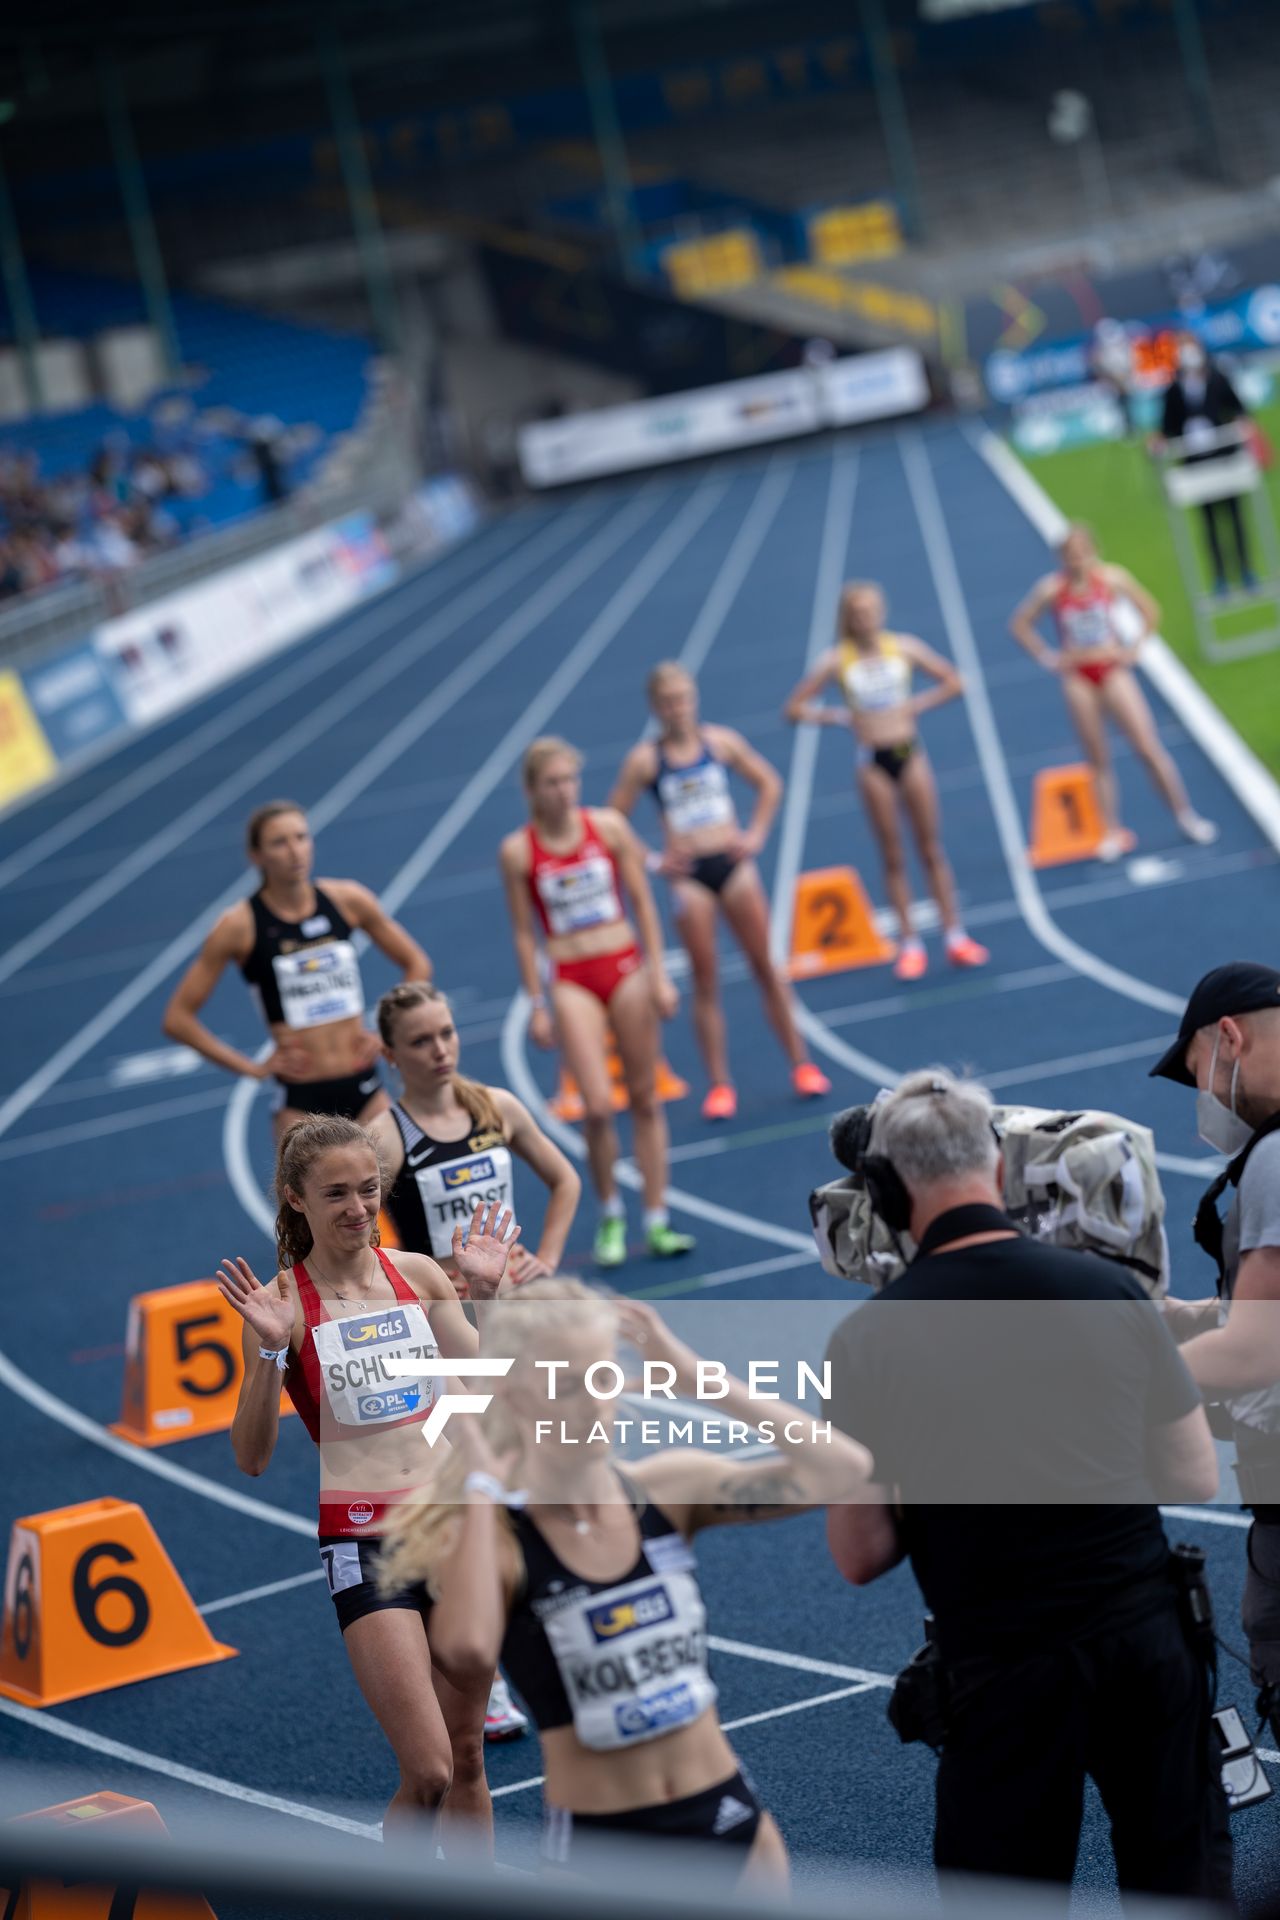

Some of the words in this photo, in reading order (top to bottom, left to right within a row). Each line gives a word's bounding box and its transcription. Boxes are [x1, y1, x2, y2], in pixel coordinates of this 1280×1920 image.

[1057, 785, 1083, 838] 1
[809, 888, 858, 947] 2
[433, 1183, 508, 1223] TROST
[175, 1313, 235, 1396] 5
[378, 1319, 403, 1337] GLS
[13, 1553, 34, 1660] 6
[72, 1541, 150, 1647] 6
